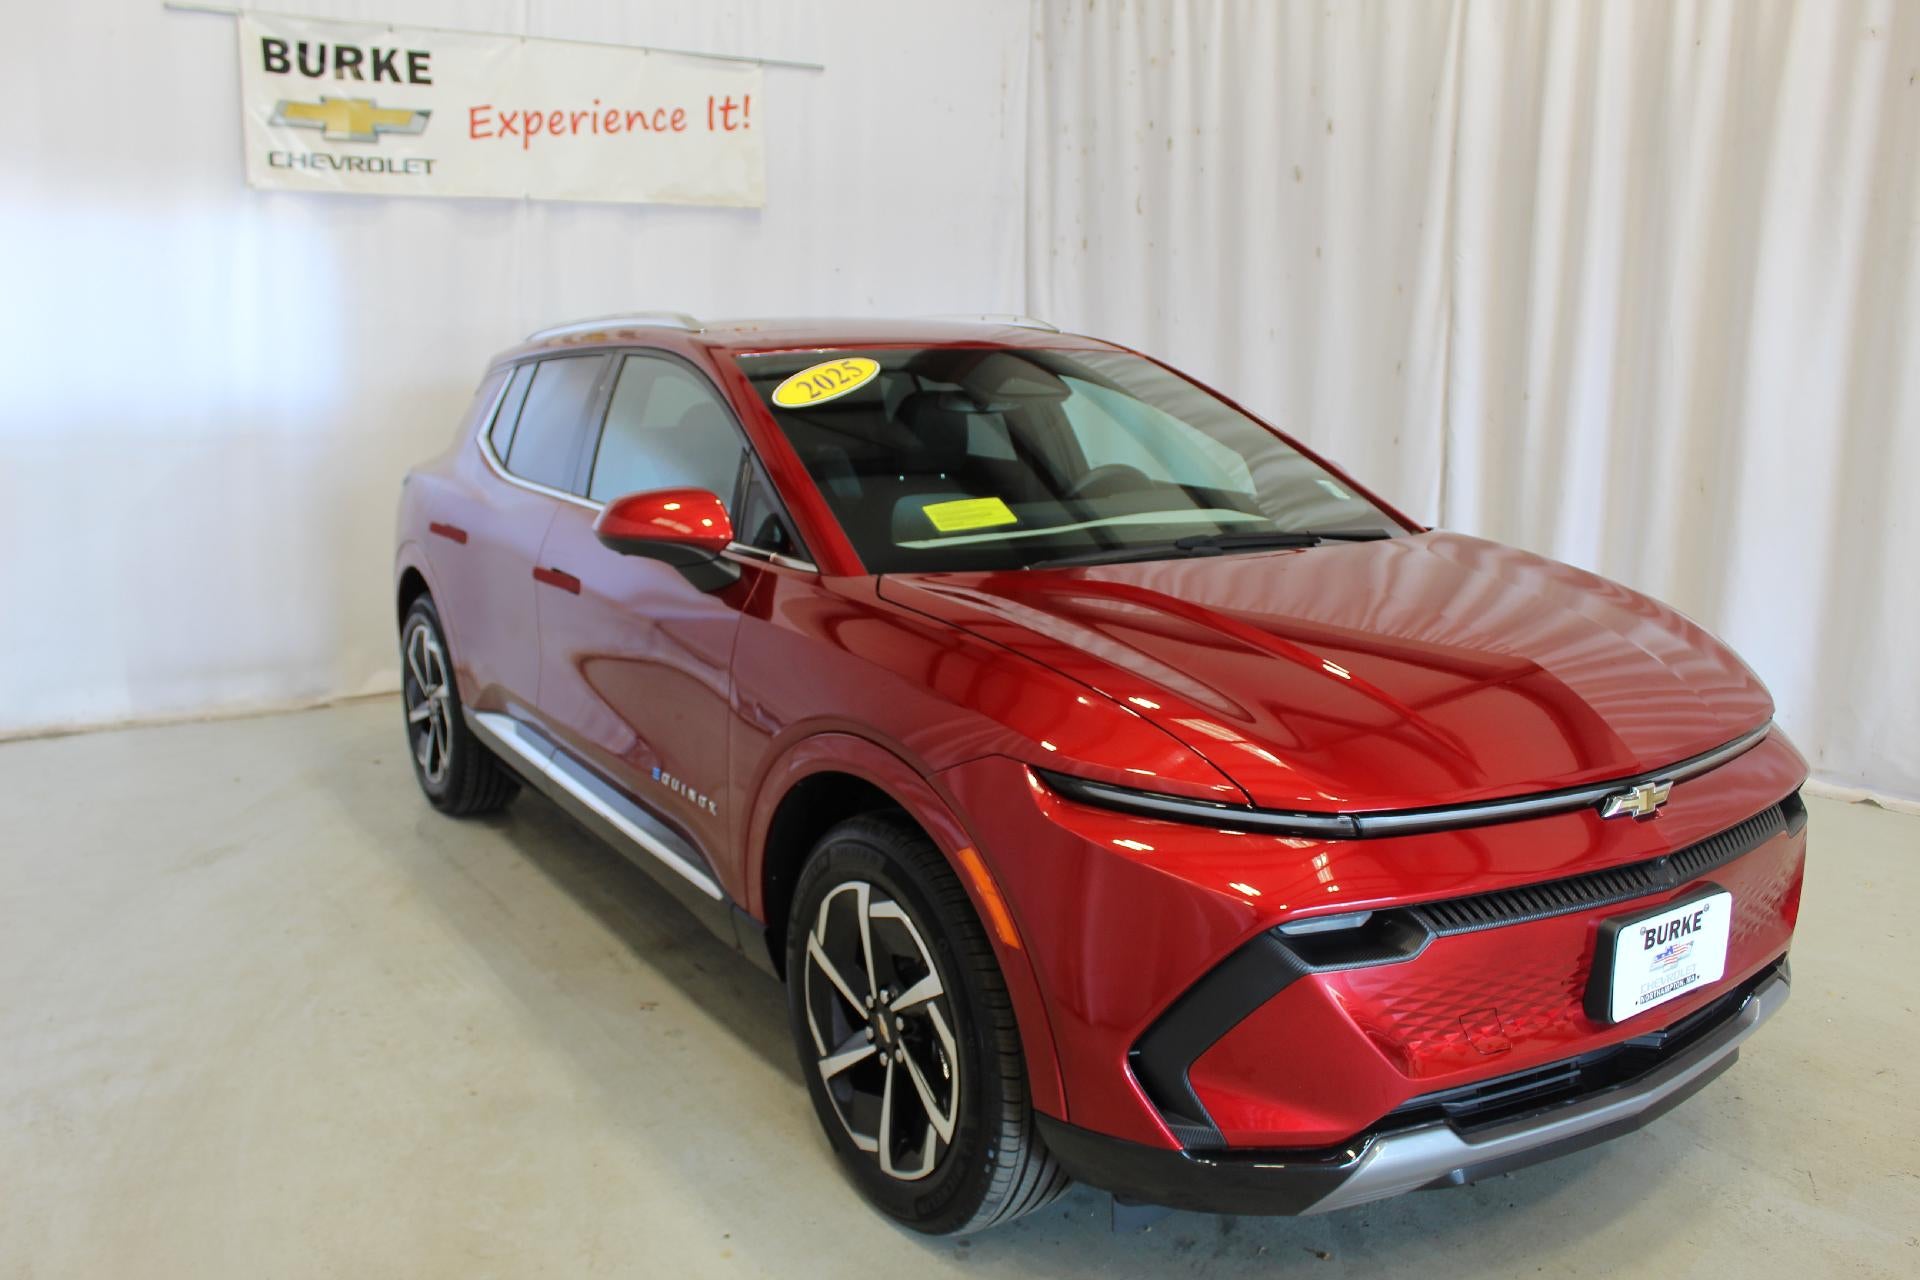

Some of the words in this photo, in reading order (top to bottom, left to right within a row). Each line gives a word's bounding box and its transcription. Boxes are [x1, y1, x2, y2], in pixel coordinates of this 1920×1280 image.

[260, 37, 433, 85] BURKE
[468, 99, 687, 150] Experience
[707, 95, 752, 132] It!
[268, 150, 437, 175] CHEVROLET
[796, 361, 863, 398] 2025
[1644, 910, 1704, 950] BURKE
